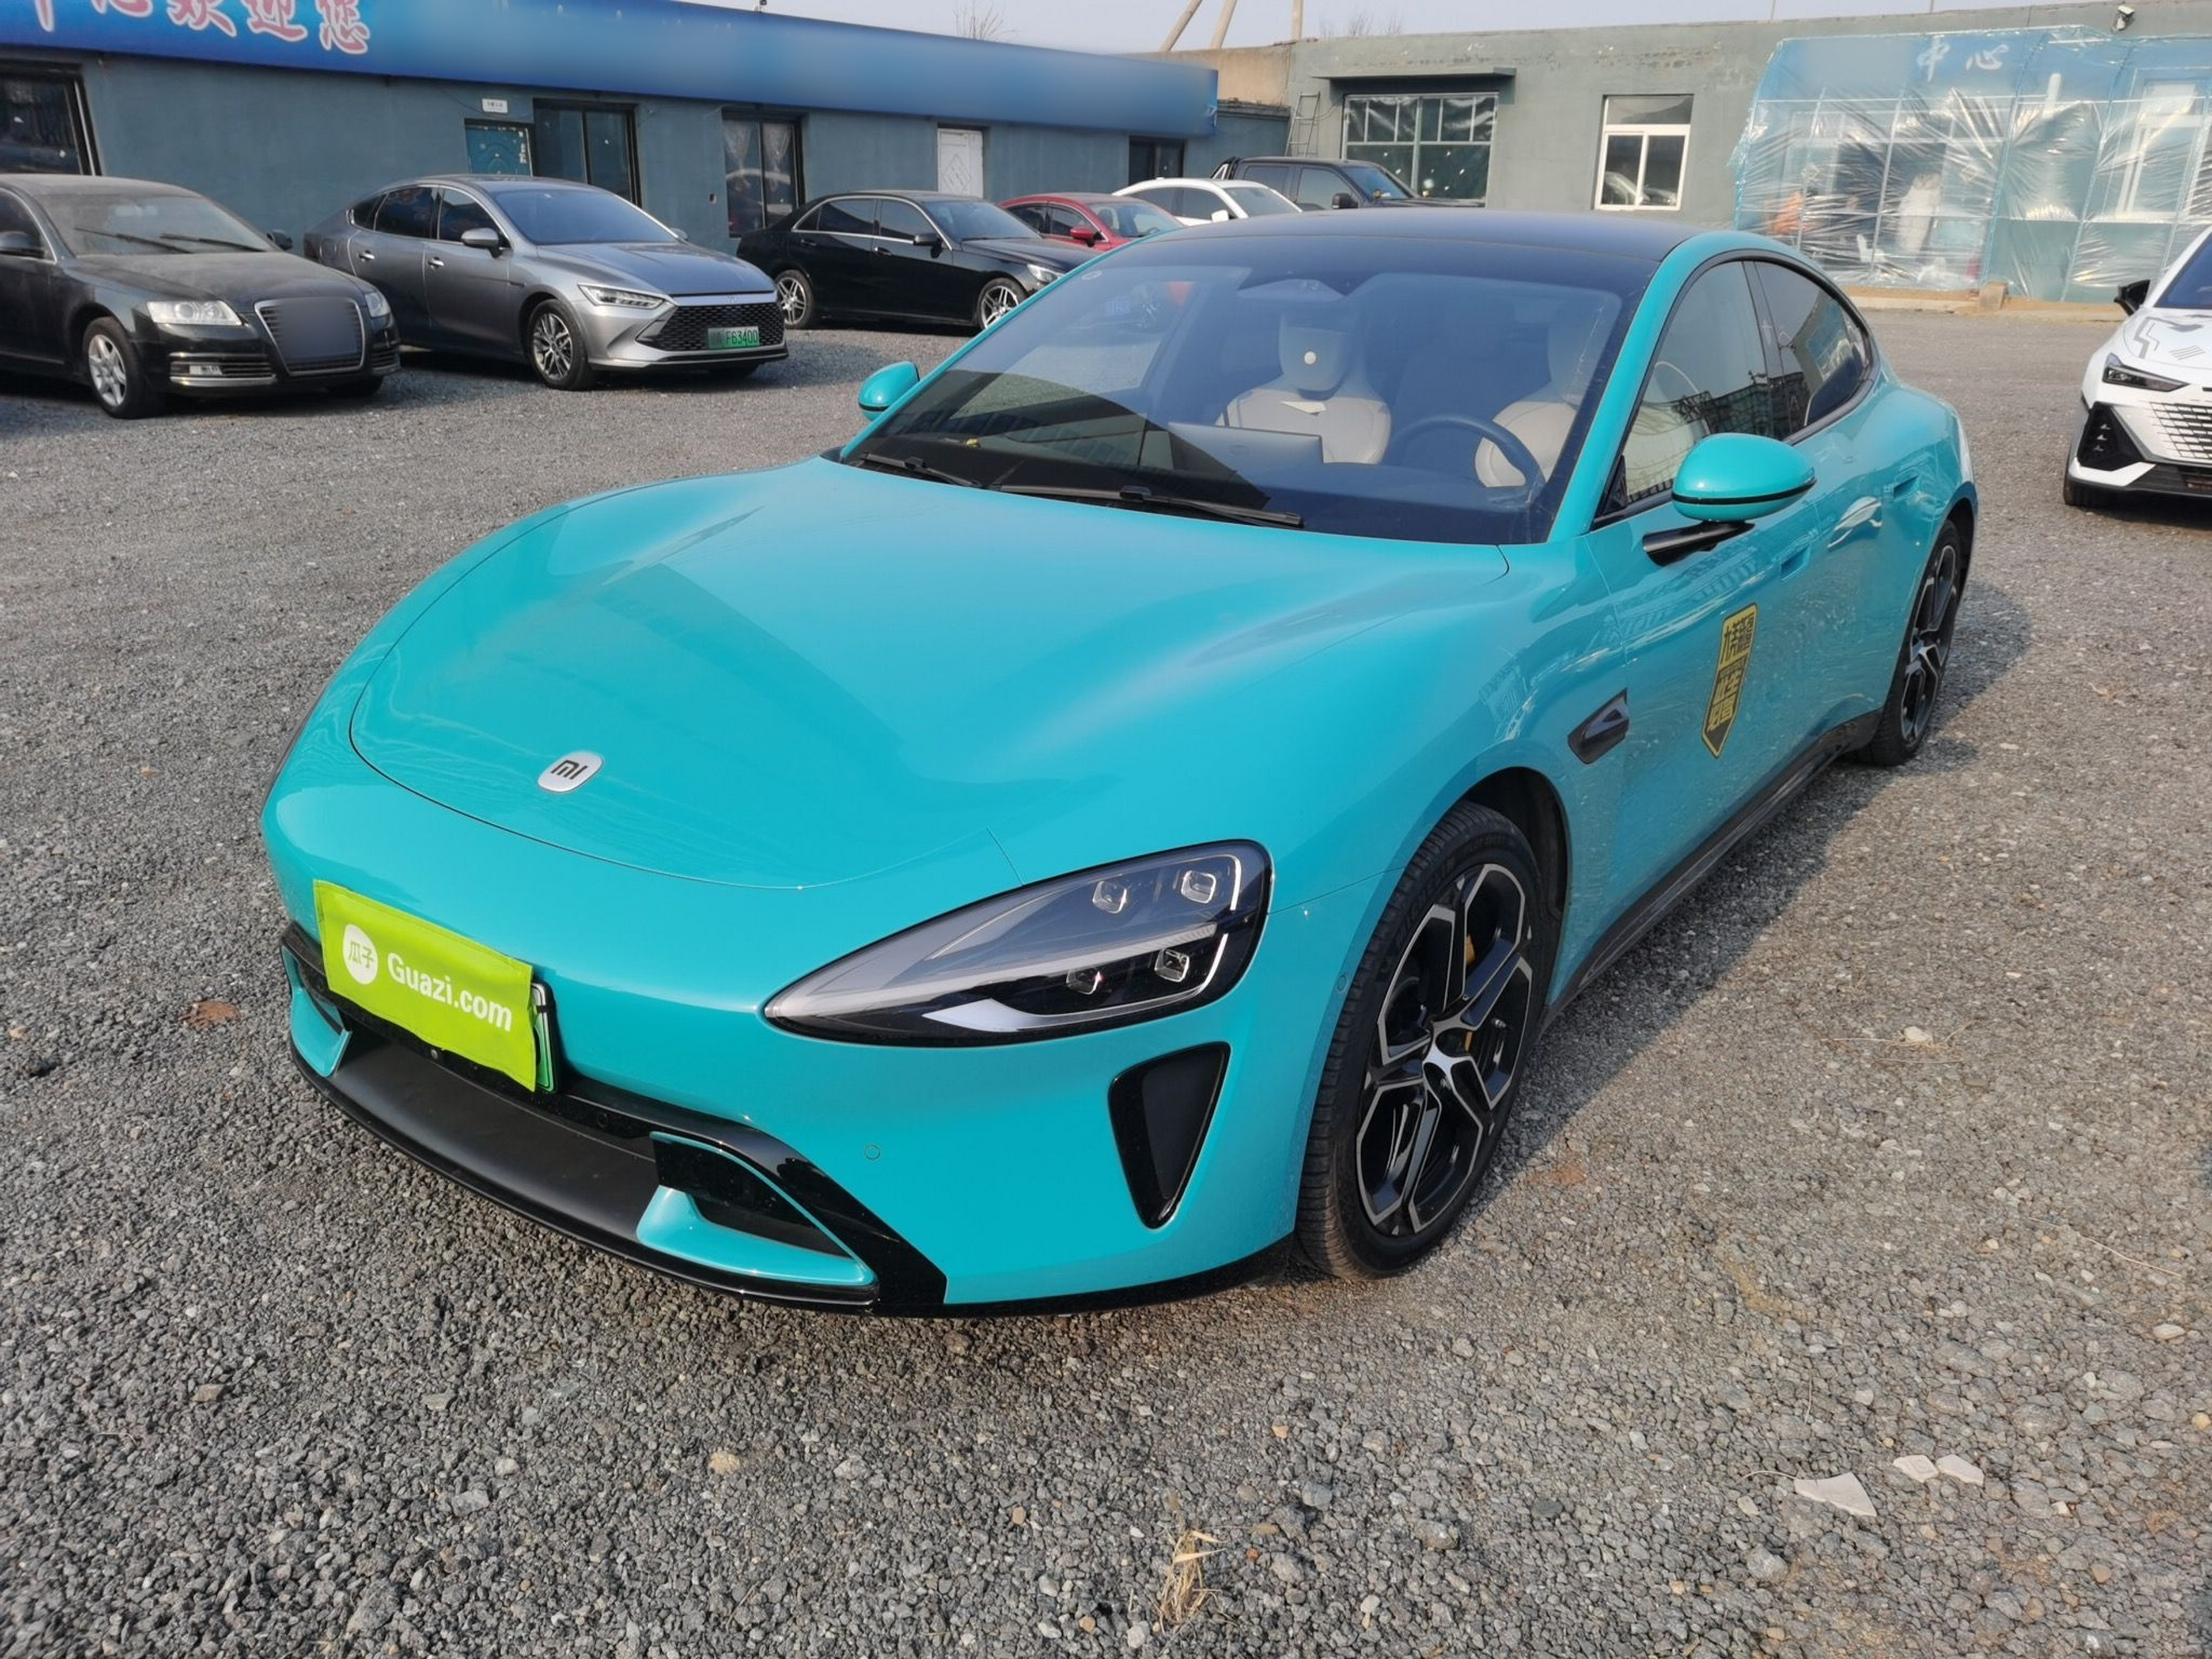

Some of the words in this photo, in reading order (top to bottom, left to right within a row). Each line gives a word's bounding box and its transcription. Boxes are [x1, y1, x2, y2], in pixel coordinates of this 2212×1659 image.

[35, 0, 370, 54] 欢迎您
[1916, 37, 2009, 82] 中心
[349, 941, 374, 968] 瓜子
[388, 952, 512, 1032] Guazi.com
